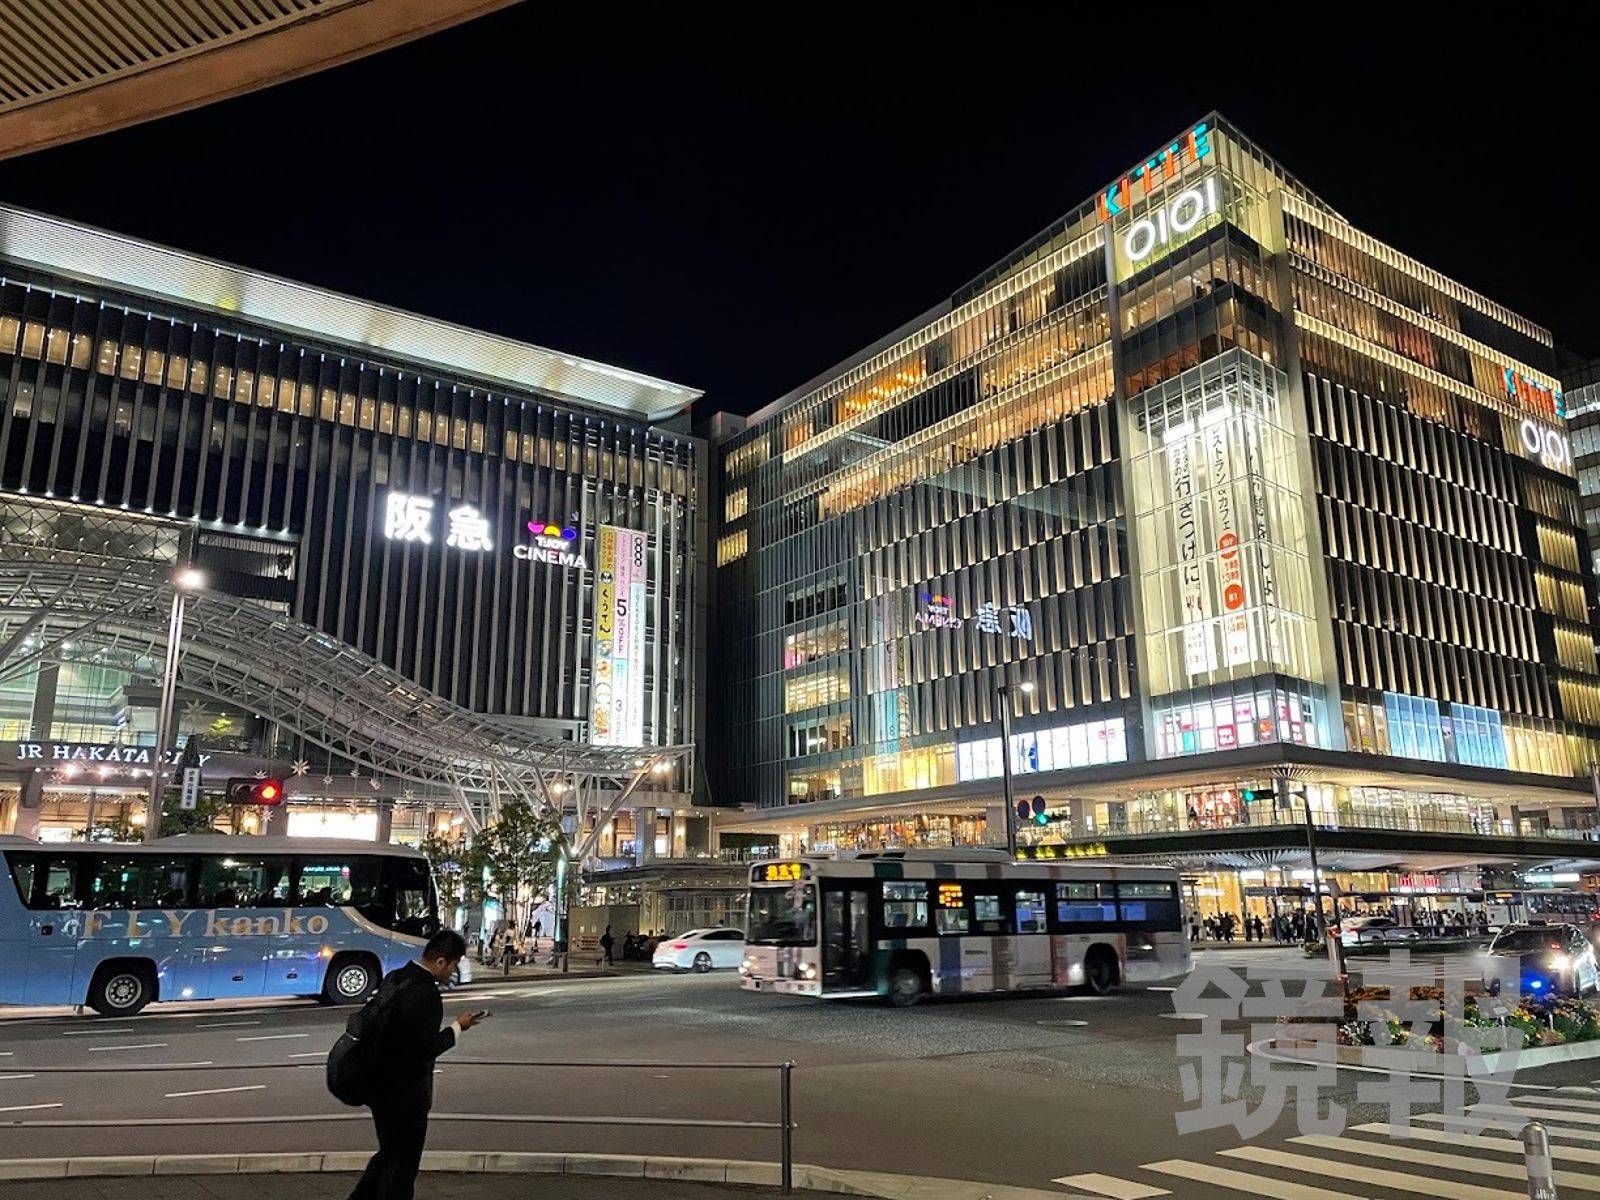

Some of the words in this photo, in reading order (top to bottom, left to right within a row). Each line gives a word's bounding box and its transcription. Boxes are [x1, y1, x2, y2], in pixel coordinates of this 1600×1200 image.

[1096, 122, 1211, 224] KITTE
[1498, 365, 1566, 417] KITTE
[384, 492, 493, 552] 阪急
[513, 544, 588, 569] CINEMA
[17, 743, 43, 760] JR
[53, 744, 149, 763] HAKATA
[158, 750, 211, 767] CIY
[81, 910, 192, 939] FLY
[206, 908, 330, 937] kanko
